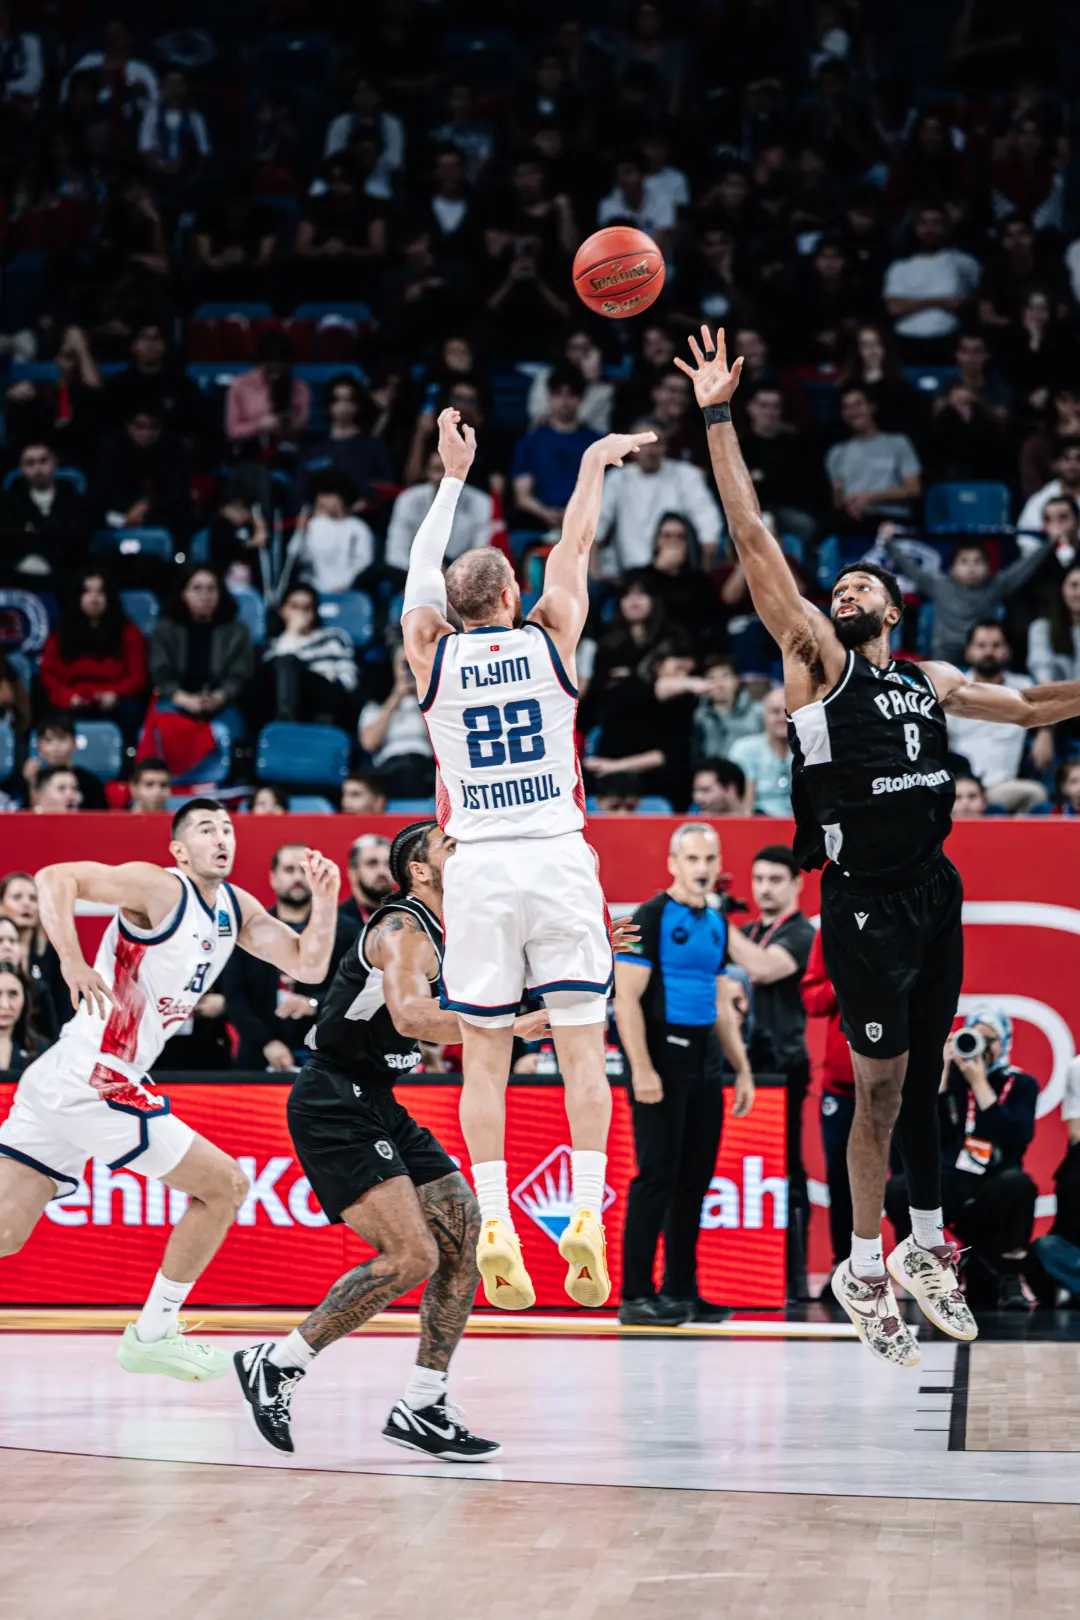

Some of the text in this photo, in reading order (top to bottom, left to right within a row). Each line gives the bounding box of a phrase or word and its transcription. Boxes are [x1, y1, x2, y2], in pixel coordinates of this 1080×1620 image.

[461, 657, 531, 689] FLYNN
[873, 690, 936, 720] PAOK
[462, 699, 546, 768] 22
[903, 723, 921, 762] 8
[699, 1156, 788, 1229] ah
